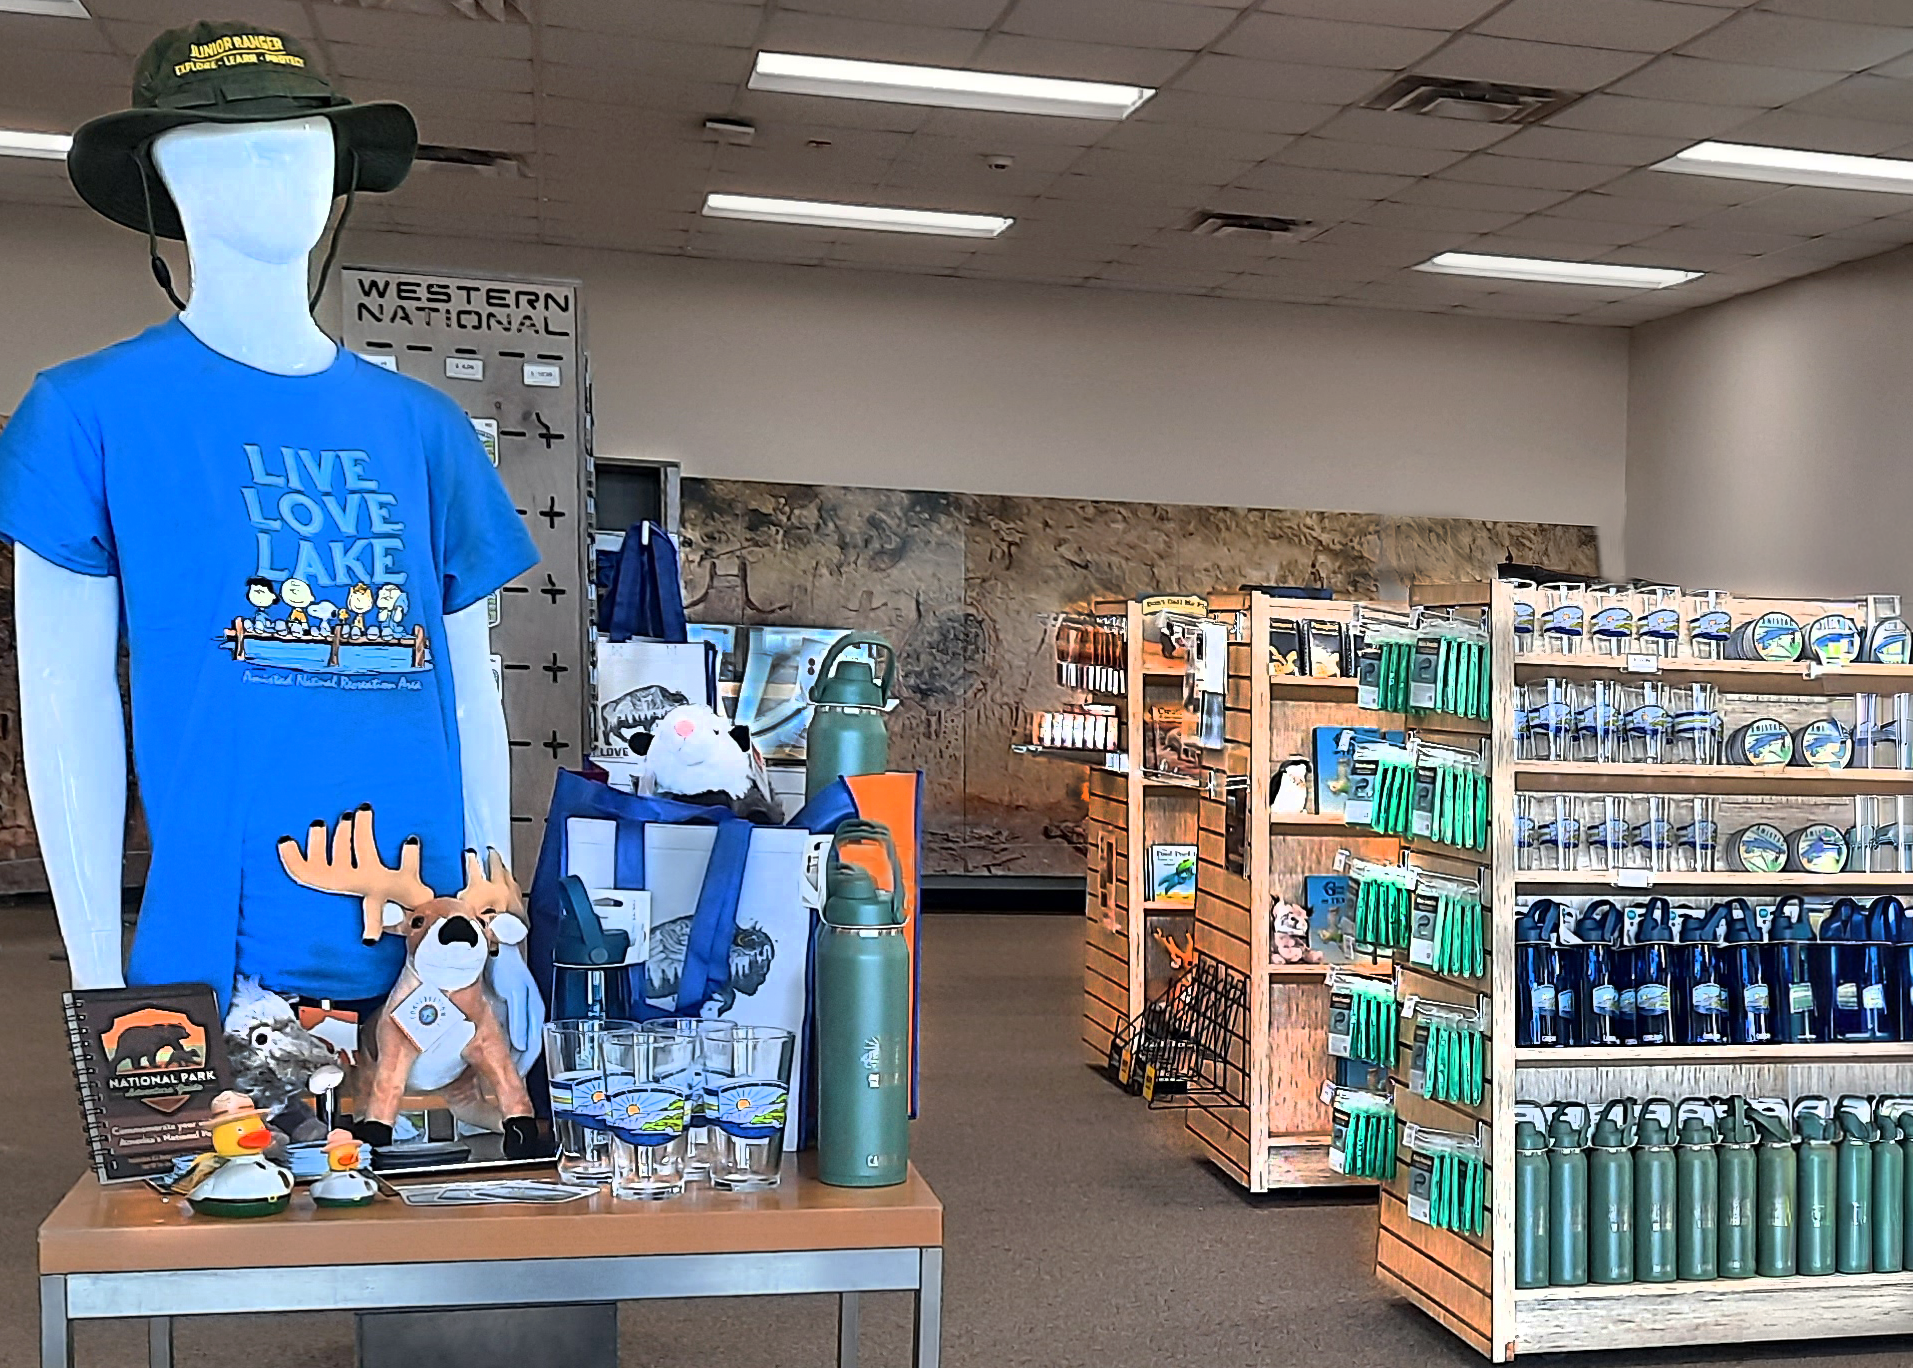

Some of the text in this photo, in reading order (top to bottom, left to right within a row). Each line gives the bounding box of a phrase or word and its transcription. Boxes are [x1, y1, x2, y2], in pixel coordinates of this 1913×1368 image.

[190, 35, 284, 58] JUNIOR RANGER
[174, 53, 305, 76] EXPLORE LEARN PROTECT
[357, 278, 570, 313] WESTERN
[357, 302, 570, 337] NATIONAL
[242, 443, 379, 493] LIVE
[240, 486, 406, 538] LOVE
[255, 532, 408, 587] LAKE
[296, 673, 338, 689] National
[340, 675, 396, 690] Recreation
[397, 676, 423, 690] Area
[600, 747, 630, 757] LOVE
[109, 1070, 217, 1089] NATIONAL PARK
[177, 1122, 197, 1132] your
